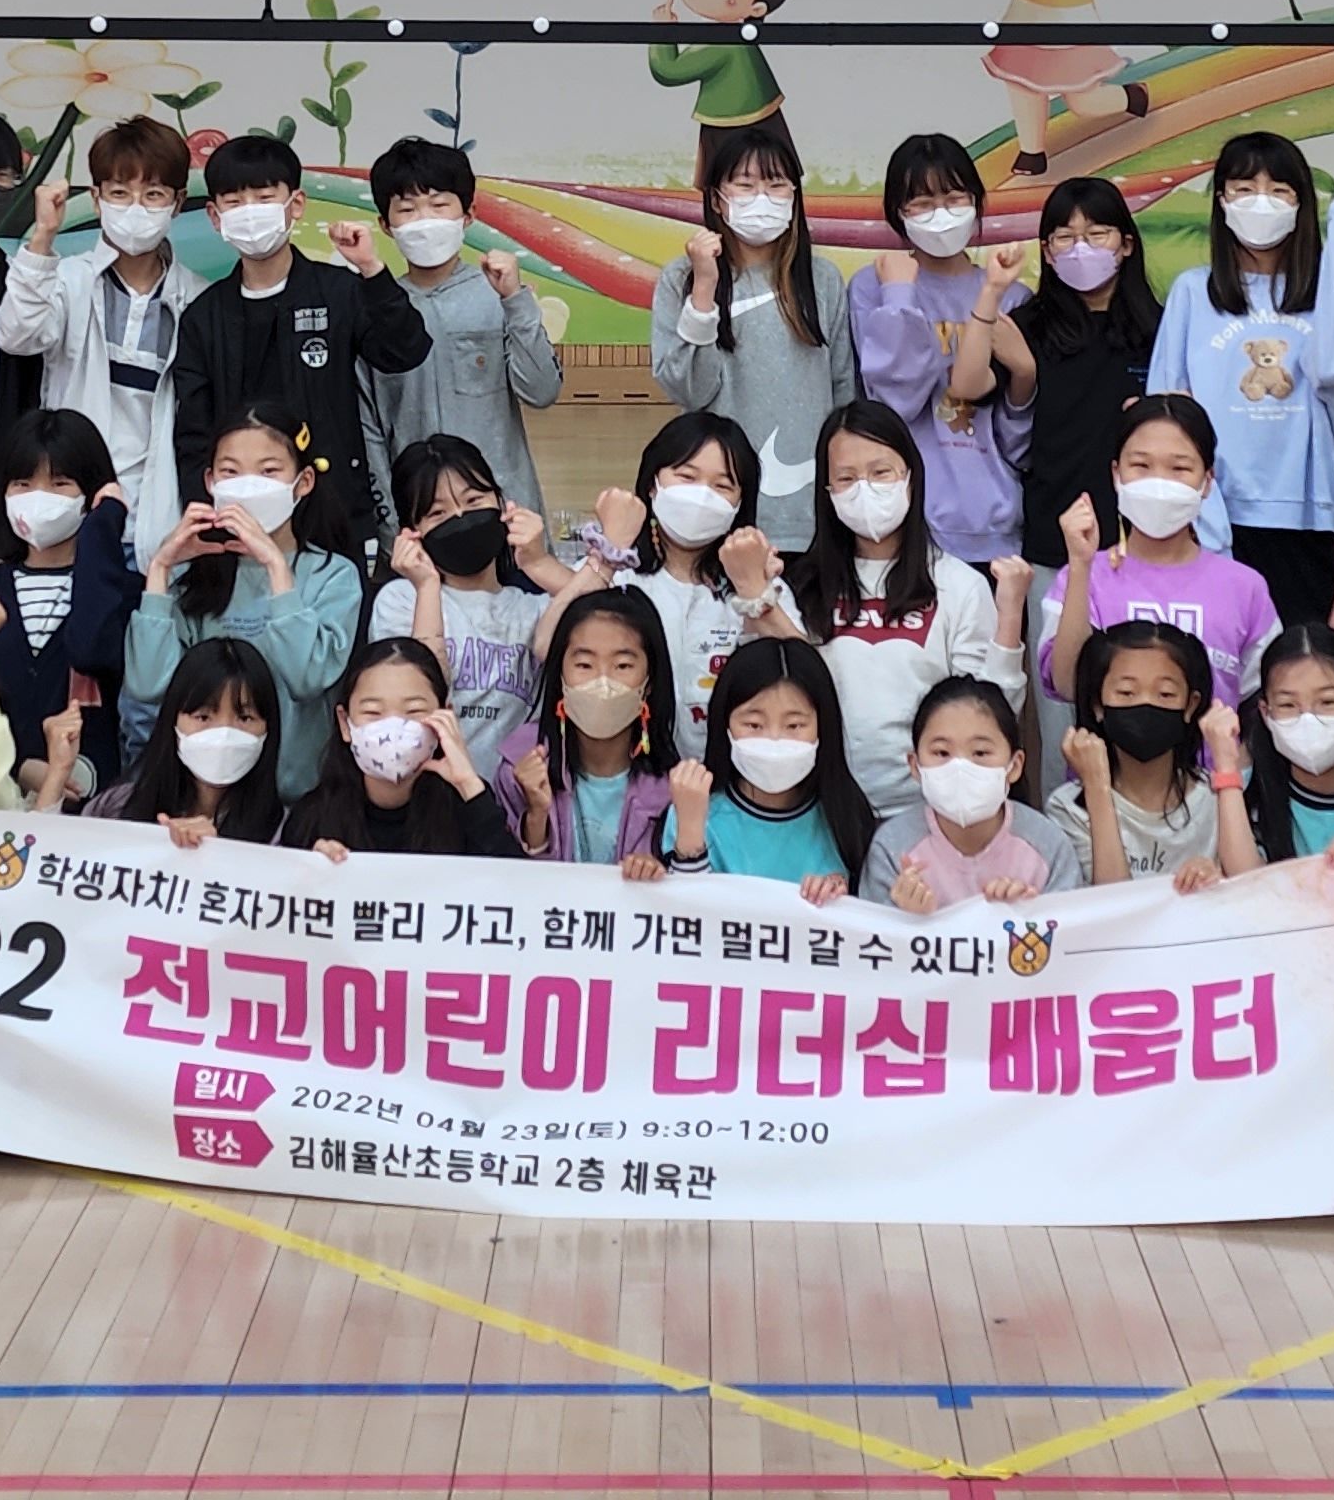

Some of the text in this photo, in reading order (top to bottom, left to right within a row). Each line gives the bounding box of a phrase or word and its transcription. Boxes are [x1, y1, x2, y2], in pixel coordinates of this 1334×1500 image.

[37, 852, 994, 977] 학생자치! 혼자가면 빨리 가고, 함께 가면 멀리 갈 수 있다!
[122, 935, 1279, 1098] 전교어린이 리더십 배움터
[194, 1067, 829, 1145] 일시 2022년 04월 23일(토) 9:30~12:00
[191, 1126, 717, 1200] 장소 김해율산초등학교 2층 체육관
